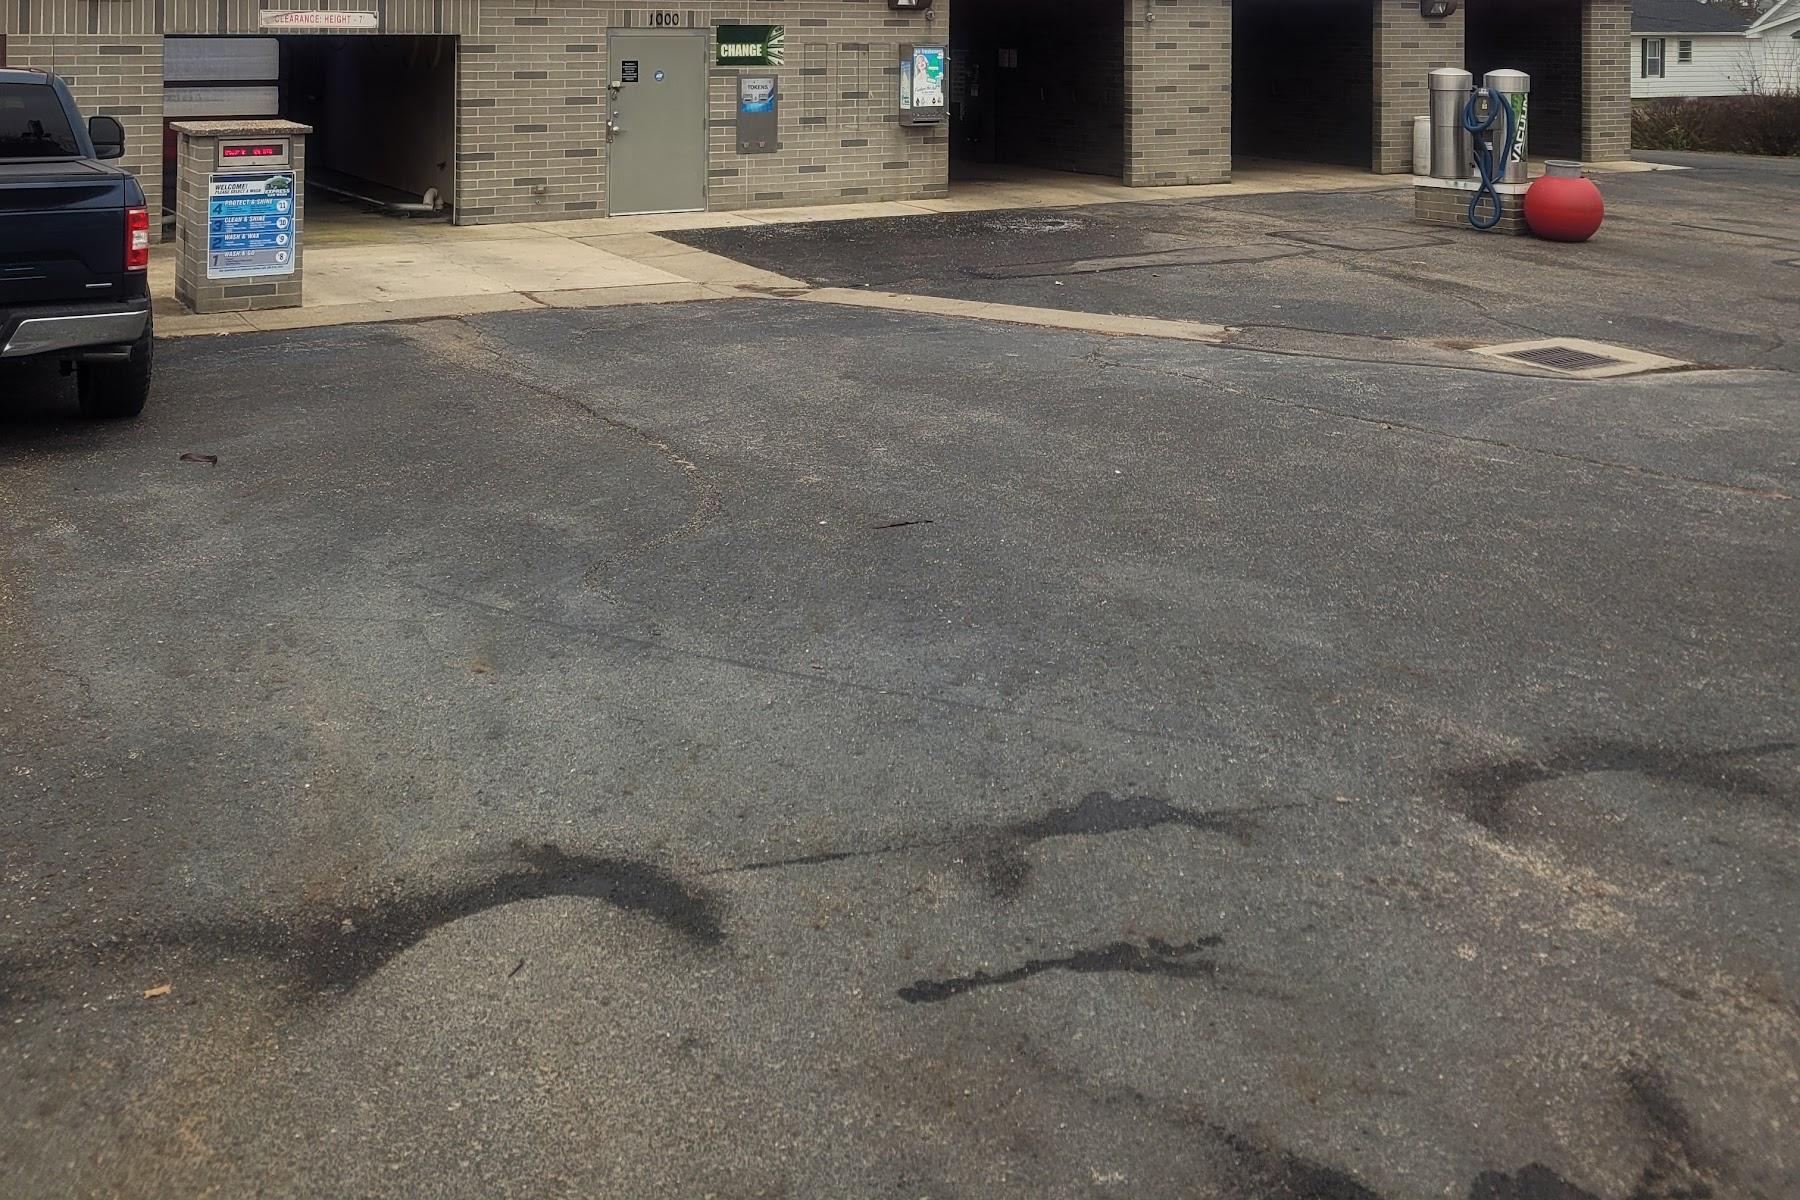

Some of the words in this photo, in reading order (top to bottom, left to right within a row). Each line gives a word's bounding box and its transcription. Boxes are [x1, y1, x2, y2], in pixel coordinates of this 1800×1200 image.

[324, 14, 351, 24] HEIGHT
[649, 13, 680, 26] 1000
[720, 43, 763, 57] CHANGE
[1511, 93, 1529, 163] VACUUM
[215, 183, 248, 191] WELCOME!
[212, 203, 223, 214] 4
[213, 220, 222, 232] 3
[212, 238, 222, 249] 2
[212, 254, 219, 266] 1
